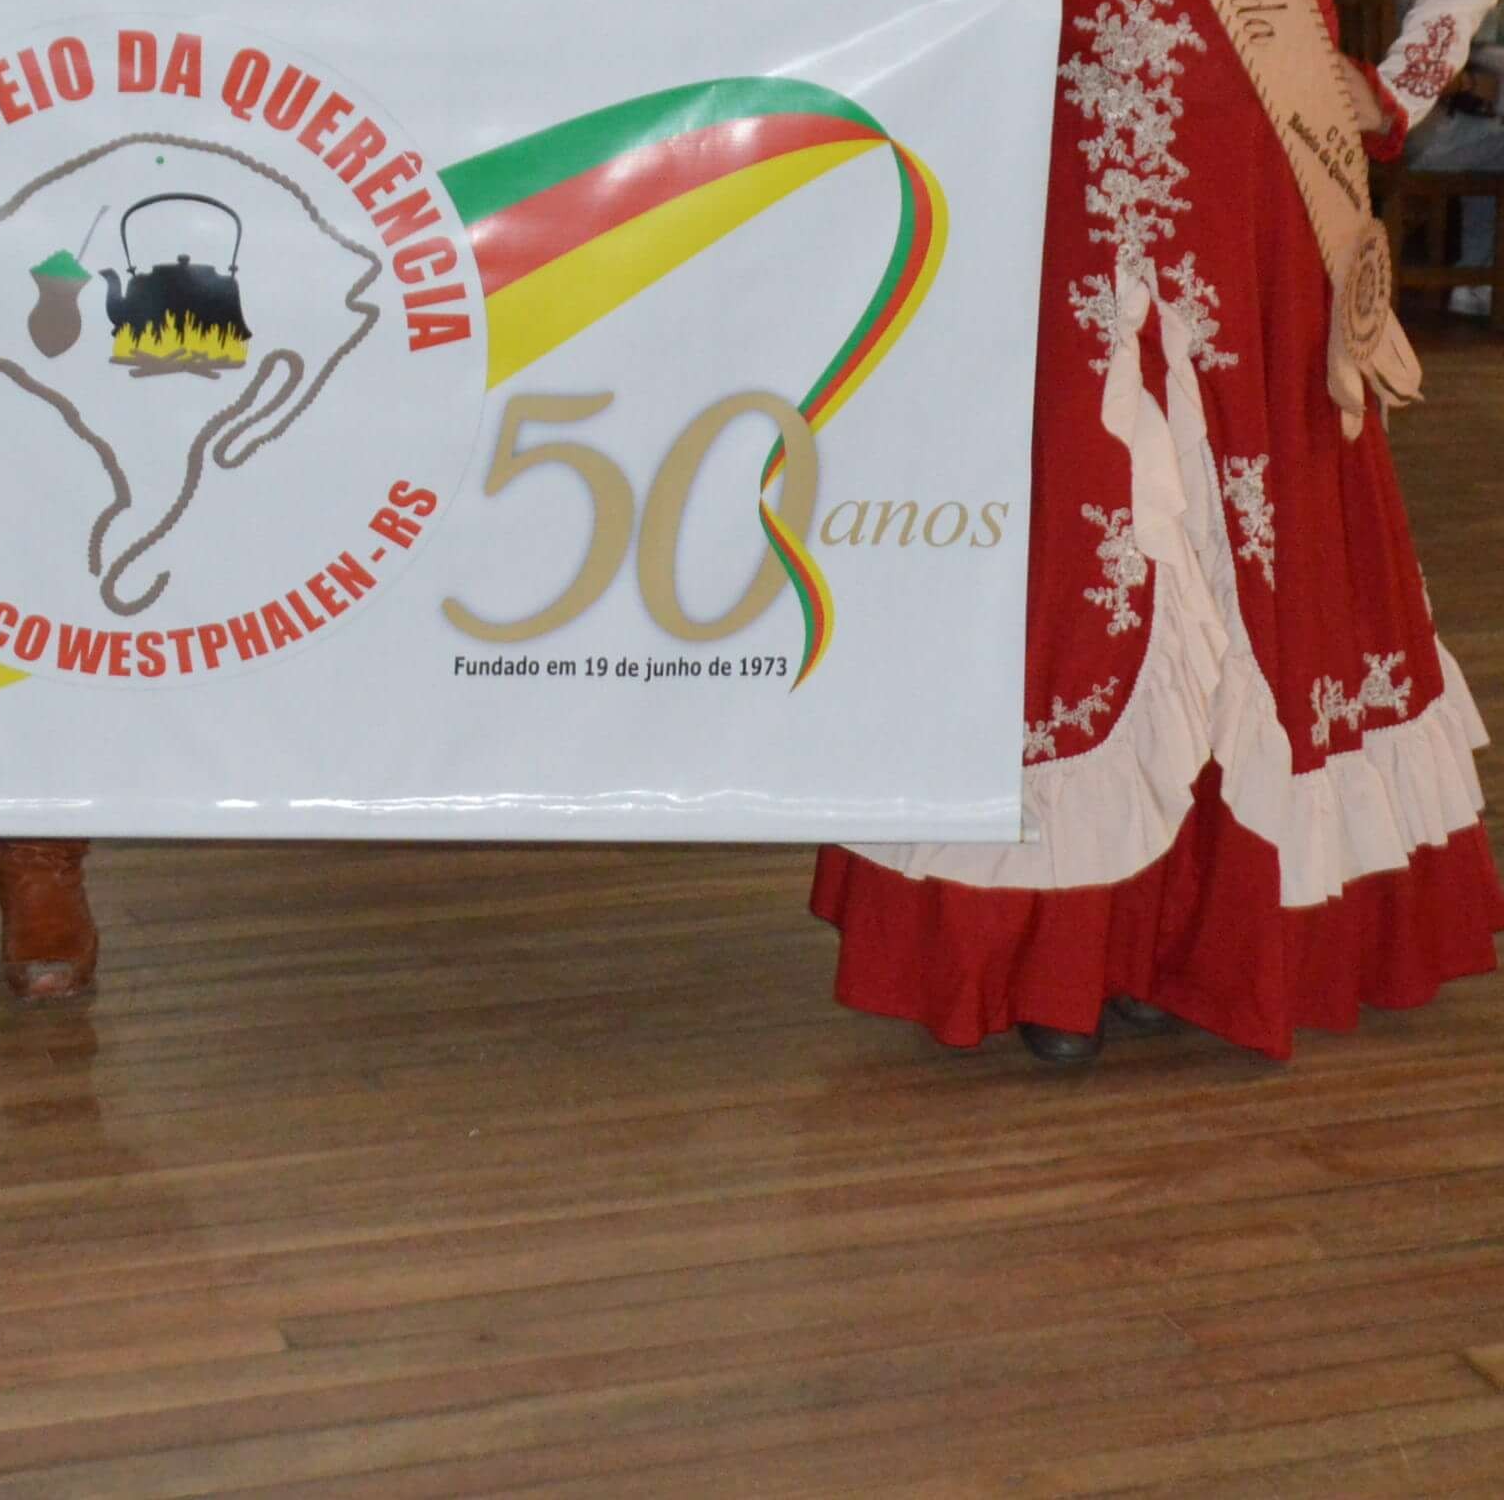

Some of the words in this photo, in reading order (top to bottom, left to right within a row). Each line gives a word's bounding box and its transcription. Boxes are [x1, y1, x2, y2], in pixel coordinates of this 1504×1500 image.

[118, 30, 203, 98] DA
[222, 48, 473, 352] QUERÊNCIA
[440, 389, 820, 644] 50
[819, 498, 1010, 549] anos
[57, 551, 377, 678] WESTPHALEN
[454, 655, 540, 676] Fundado
[546, 660, 576, 676] em
[585, 657, 608, 677] 19
[615, 657, 639, 677] de
[644, 657, 702, 682] junho
[708, 657, 732, 677] de
[740, 657, 788, 677] 1973
